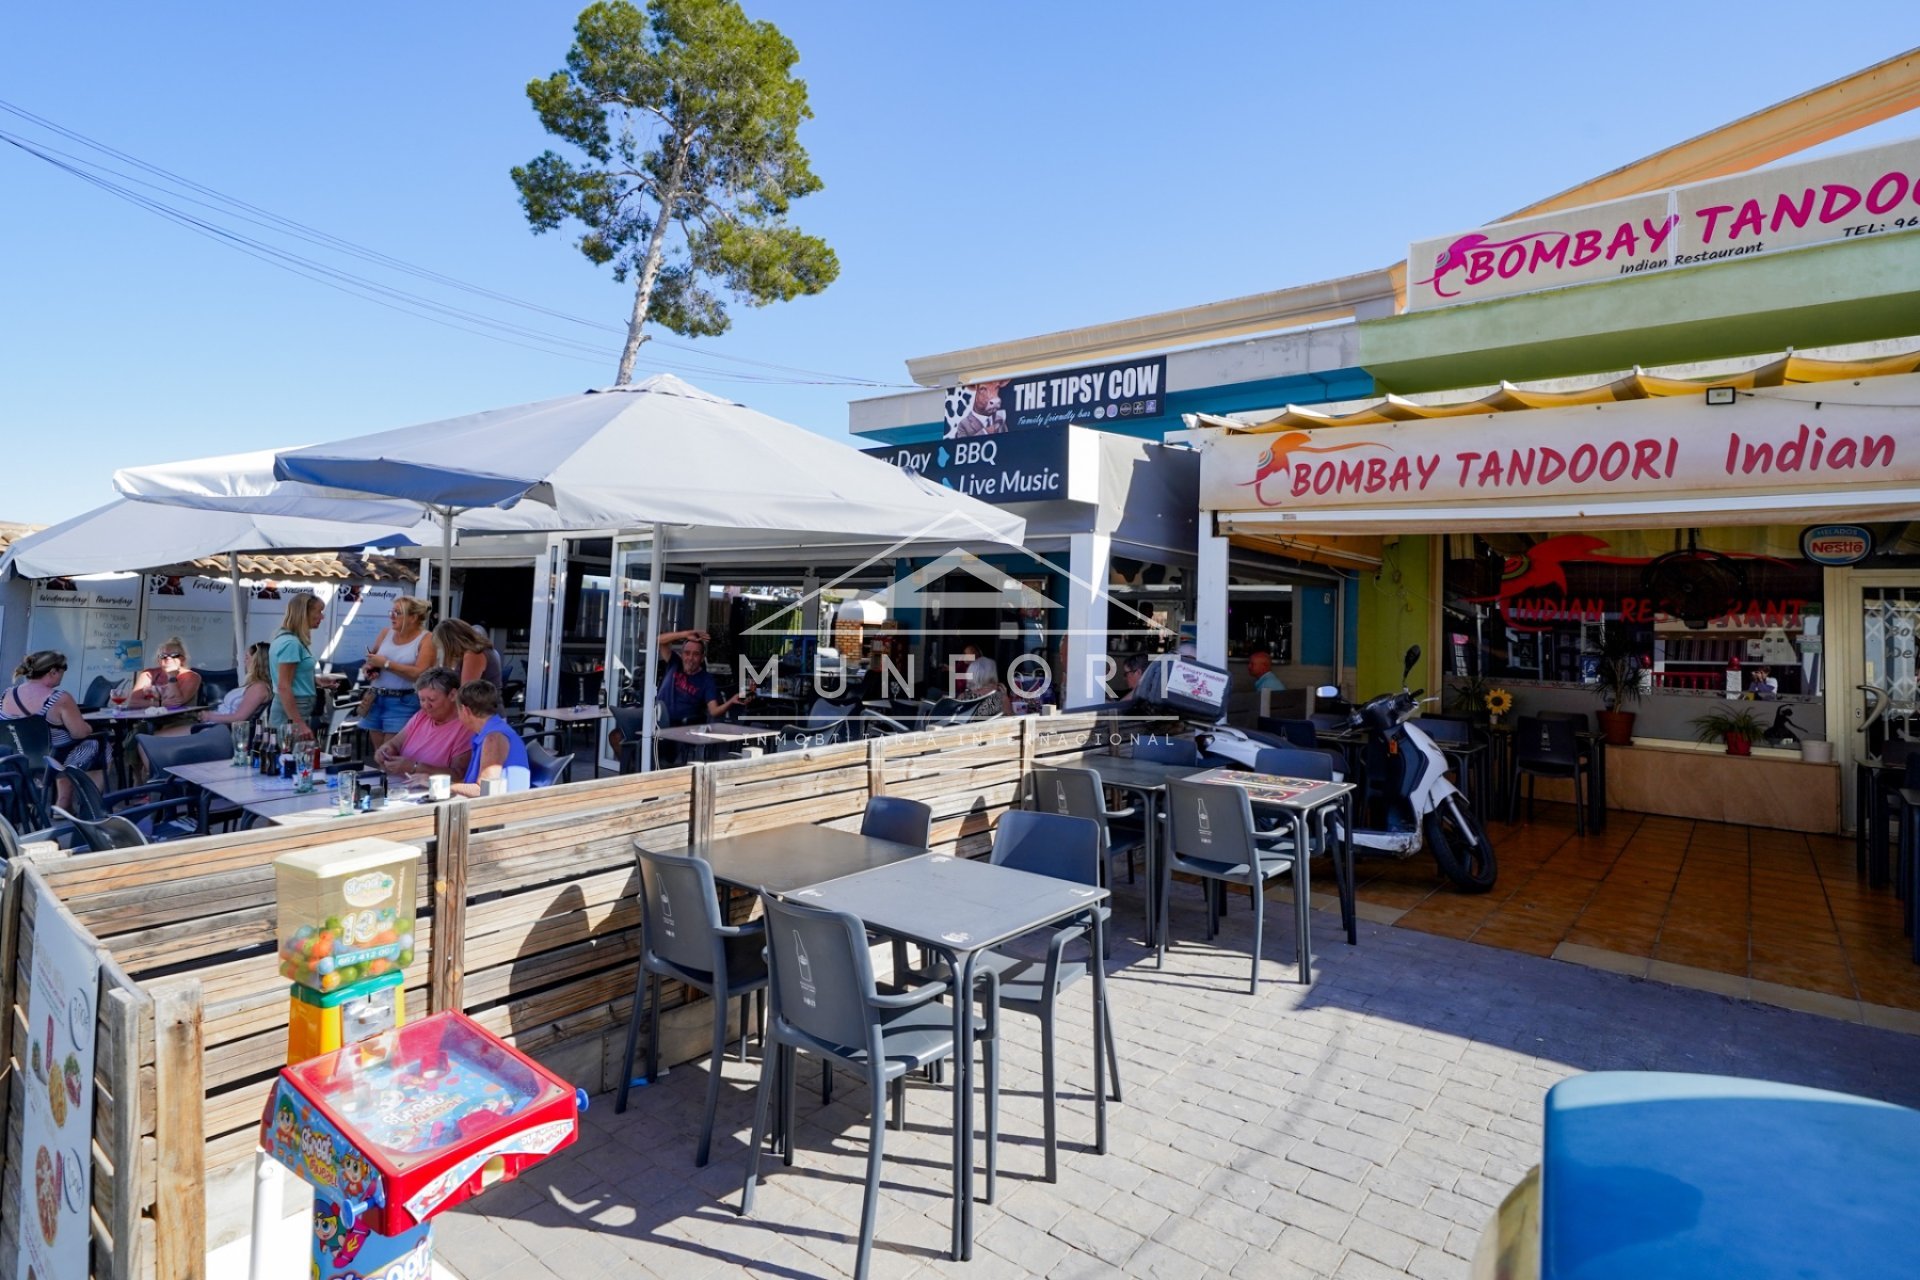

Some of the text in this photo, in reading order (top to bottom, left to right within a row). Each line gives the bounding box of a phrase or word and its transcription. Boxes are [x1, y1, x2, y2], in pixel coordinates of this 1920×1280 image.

[1465, 171, 1920, 286] BOMBAY TANDO
[1619, 257, 1668, 275] Indian
[1674, 241, 1765, 266] Restaurant
[1842, 223, 1886, 238] TEL:
[1014, 364, 1160, 412] THE TIPSY COW
[1017, 414, 1044, 426] Family
[1044, 408, 1078, 427] friendly
[1077, 408, 1091, 418] bar
[897, 440, 998, 472] Day BBQ
[1290, 423, 1897, 497] BOMBAY TANDOORI Indian
[958, 467, 1060, 496] Live Music
[1817, 528, 1858, 536] HELADOS
[40, 593, 88, 605] Wednesday
[192, 579, 227, 594] Friday
[366, 588, 397, 600] Sunday
[96, 594, 134, 606] Thursday
[1515, 598, 1605, 624] INDIAN
